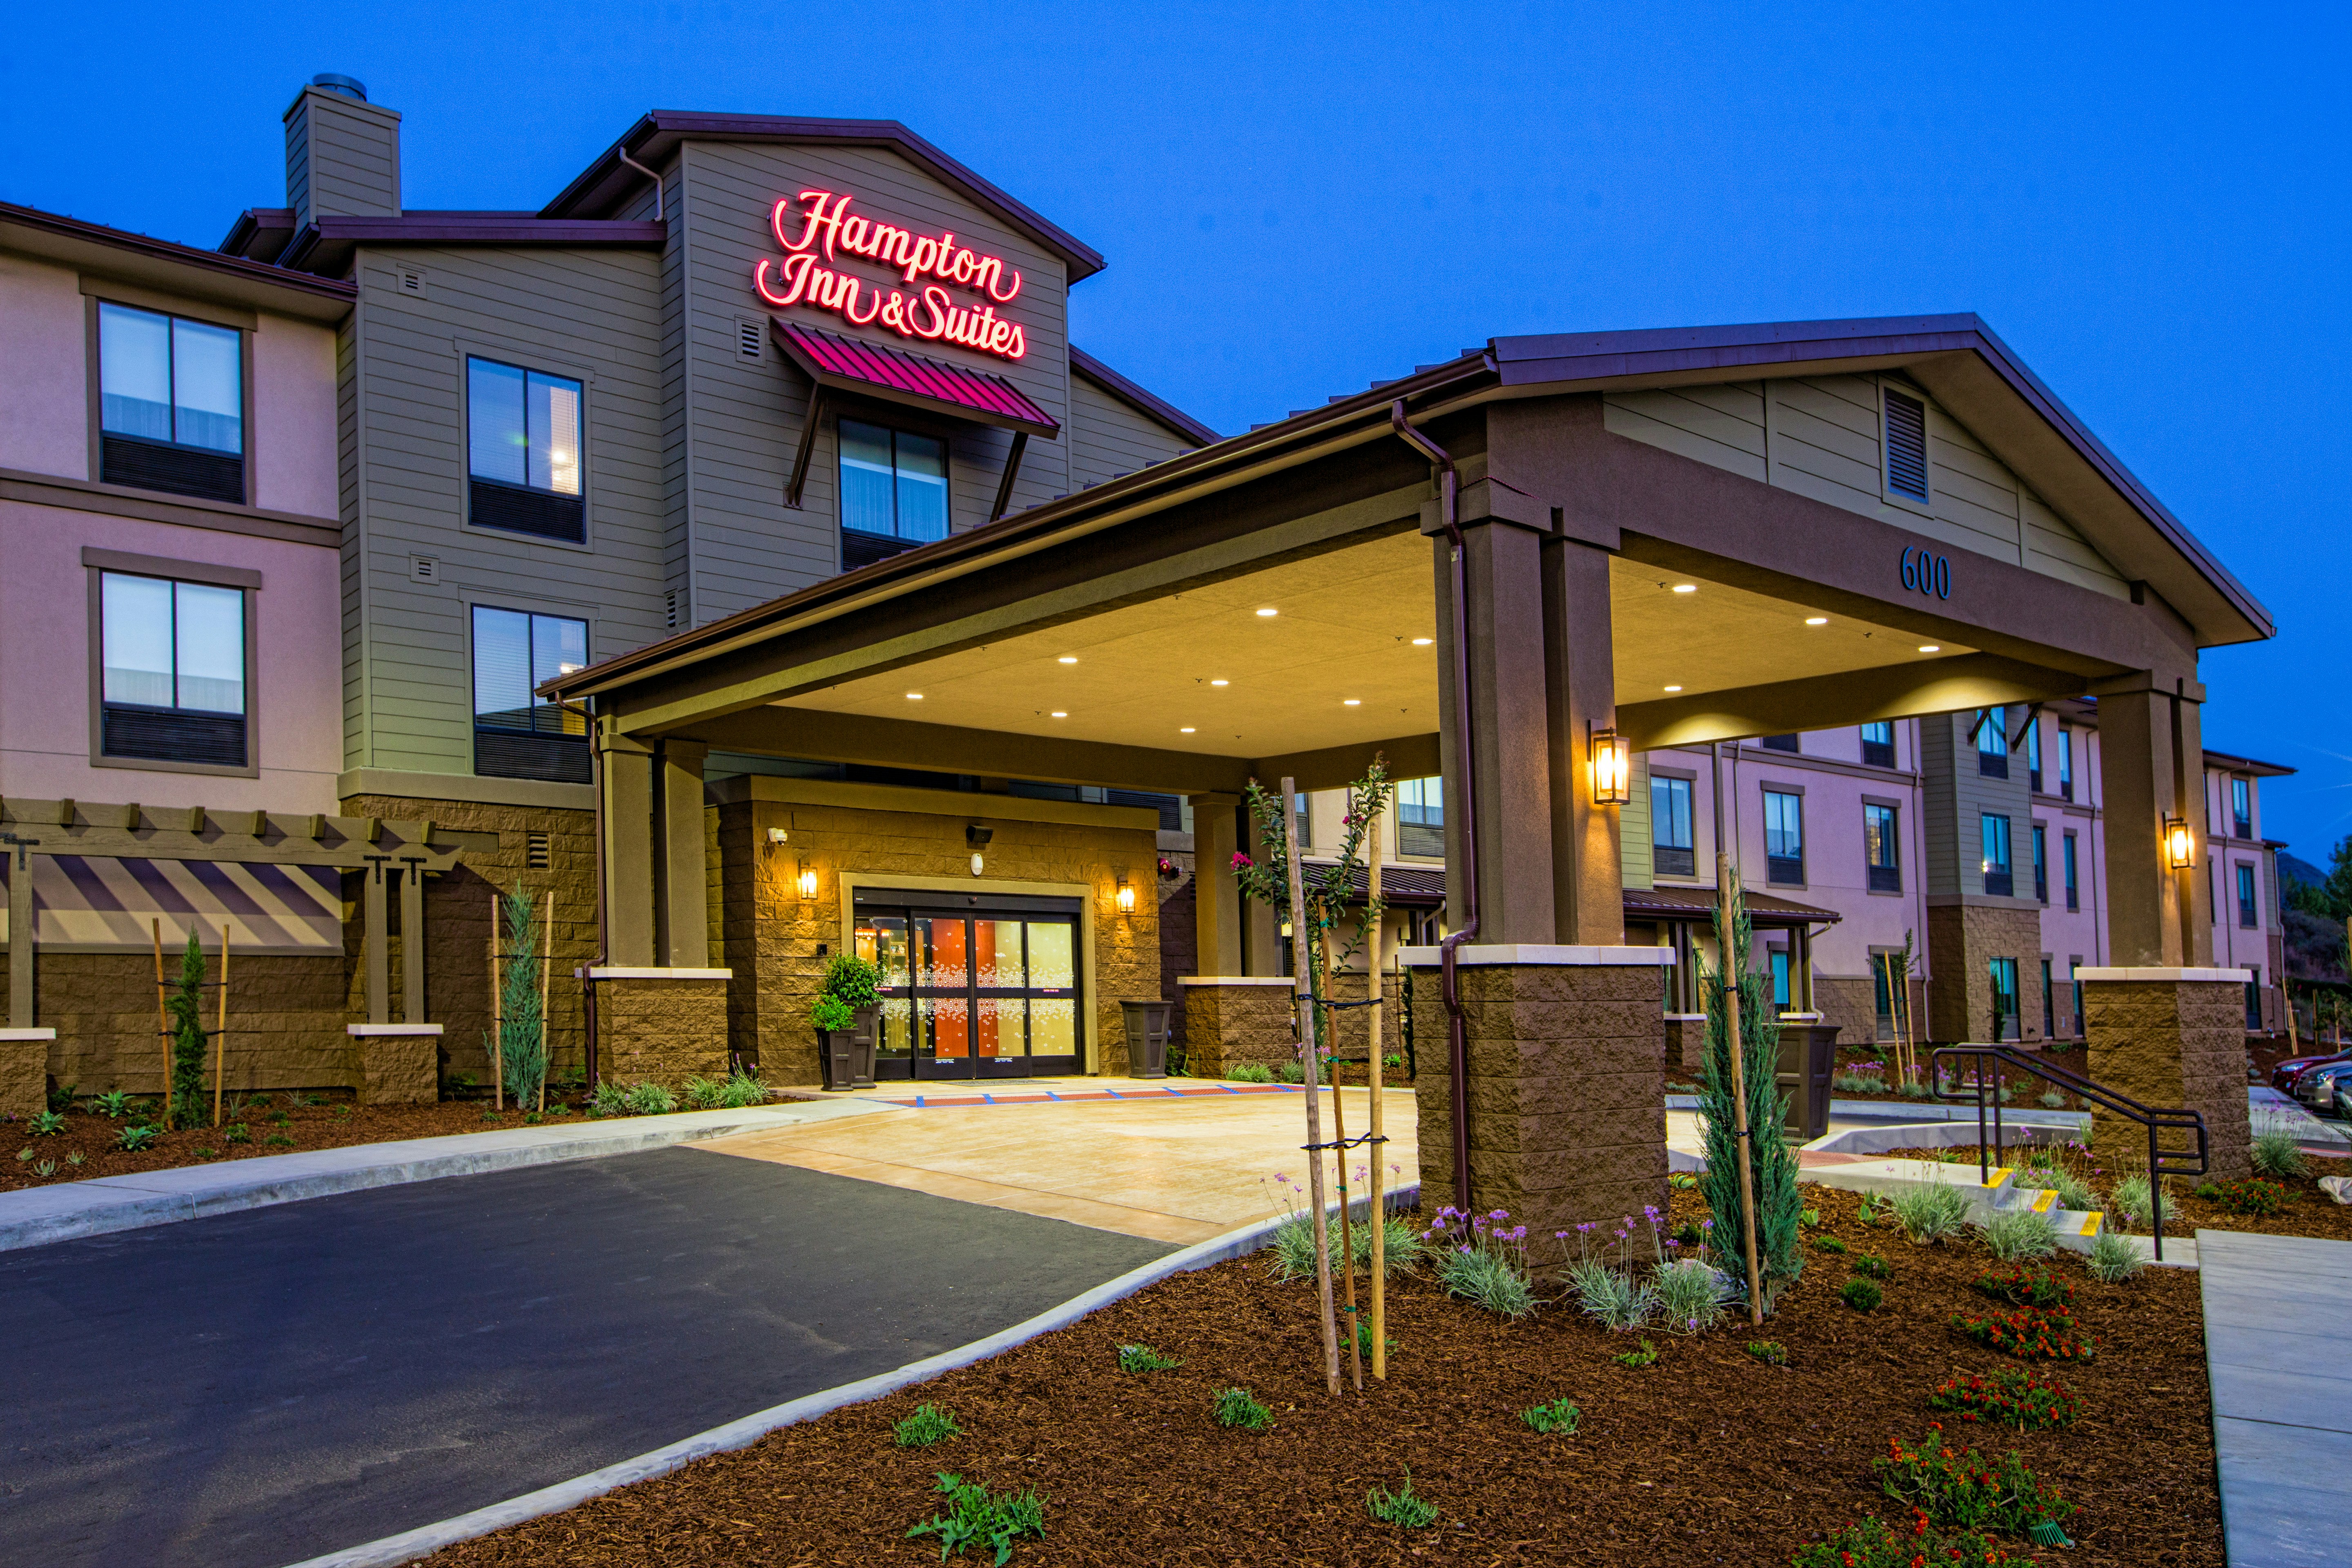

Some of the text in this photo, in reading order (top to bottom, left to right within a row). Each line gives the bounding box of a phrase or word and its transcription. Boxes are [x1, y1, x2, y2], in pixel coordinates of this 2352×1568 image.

[774, 191, 1020, 301] Hampton
[757, 253, 1025, 358] Inn & Suites
[1901, 546, 1951, 599] 600
